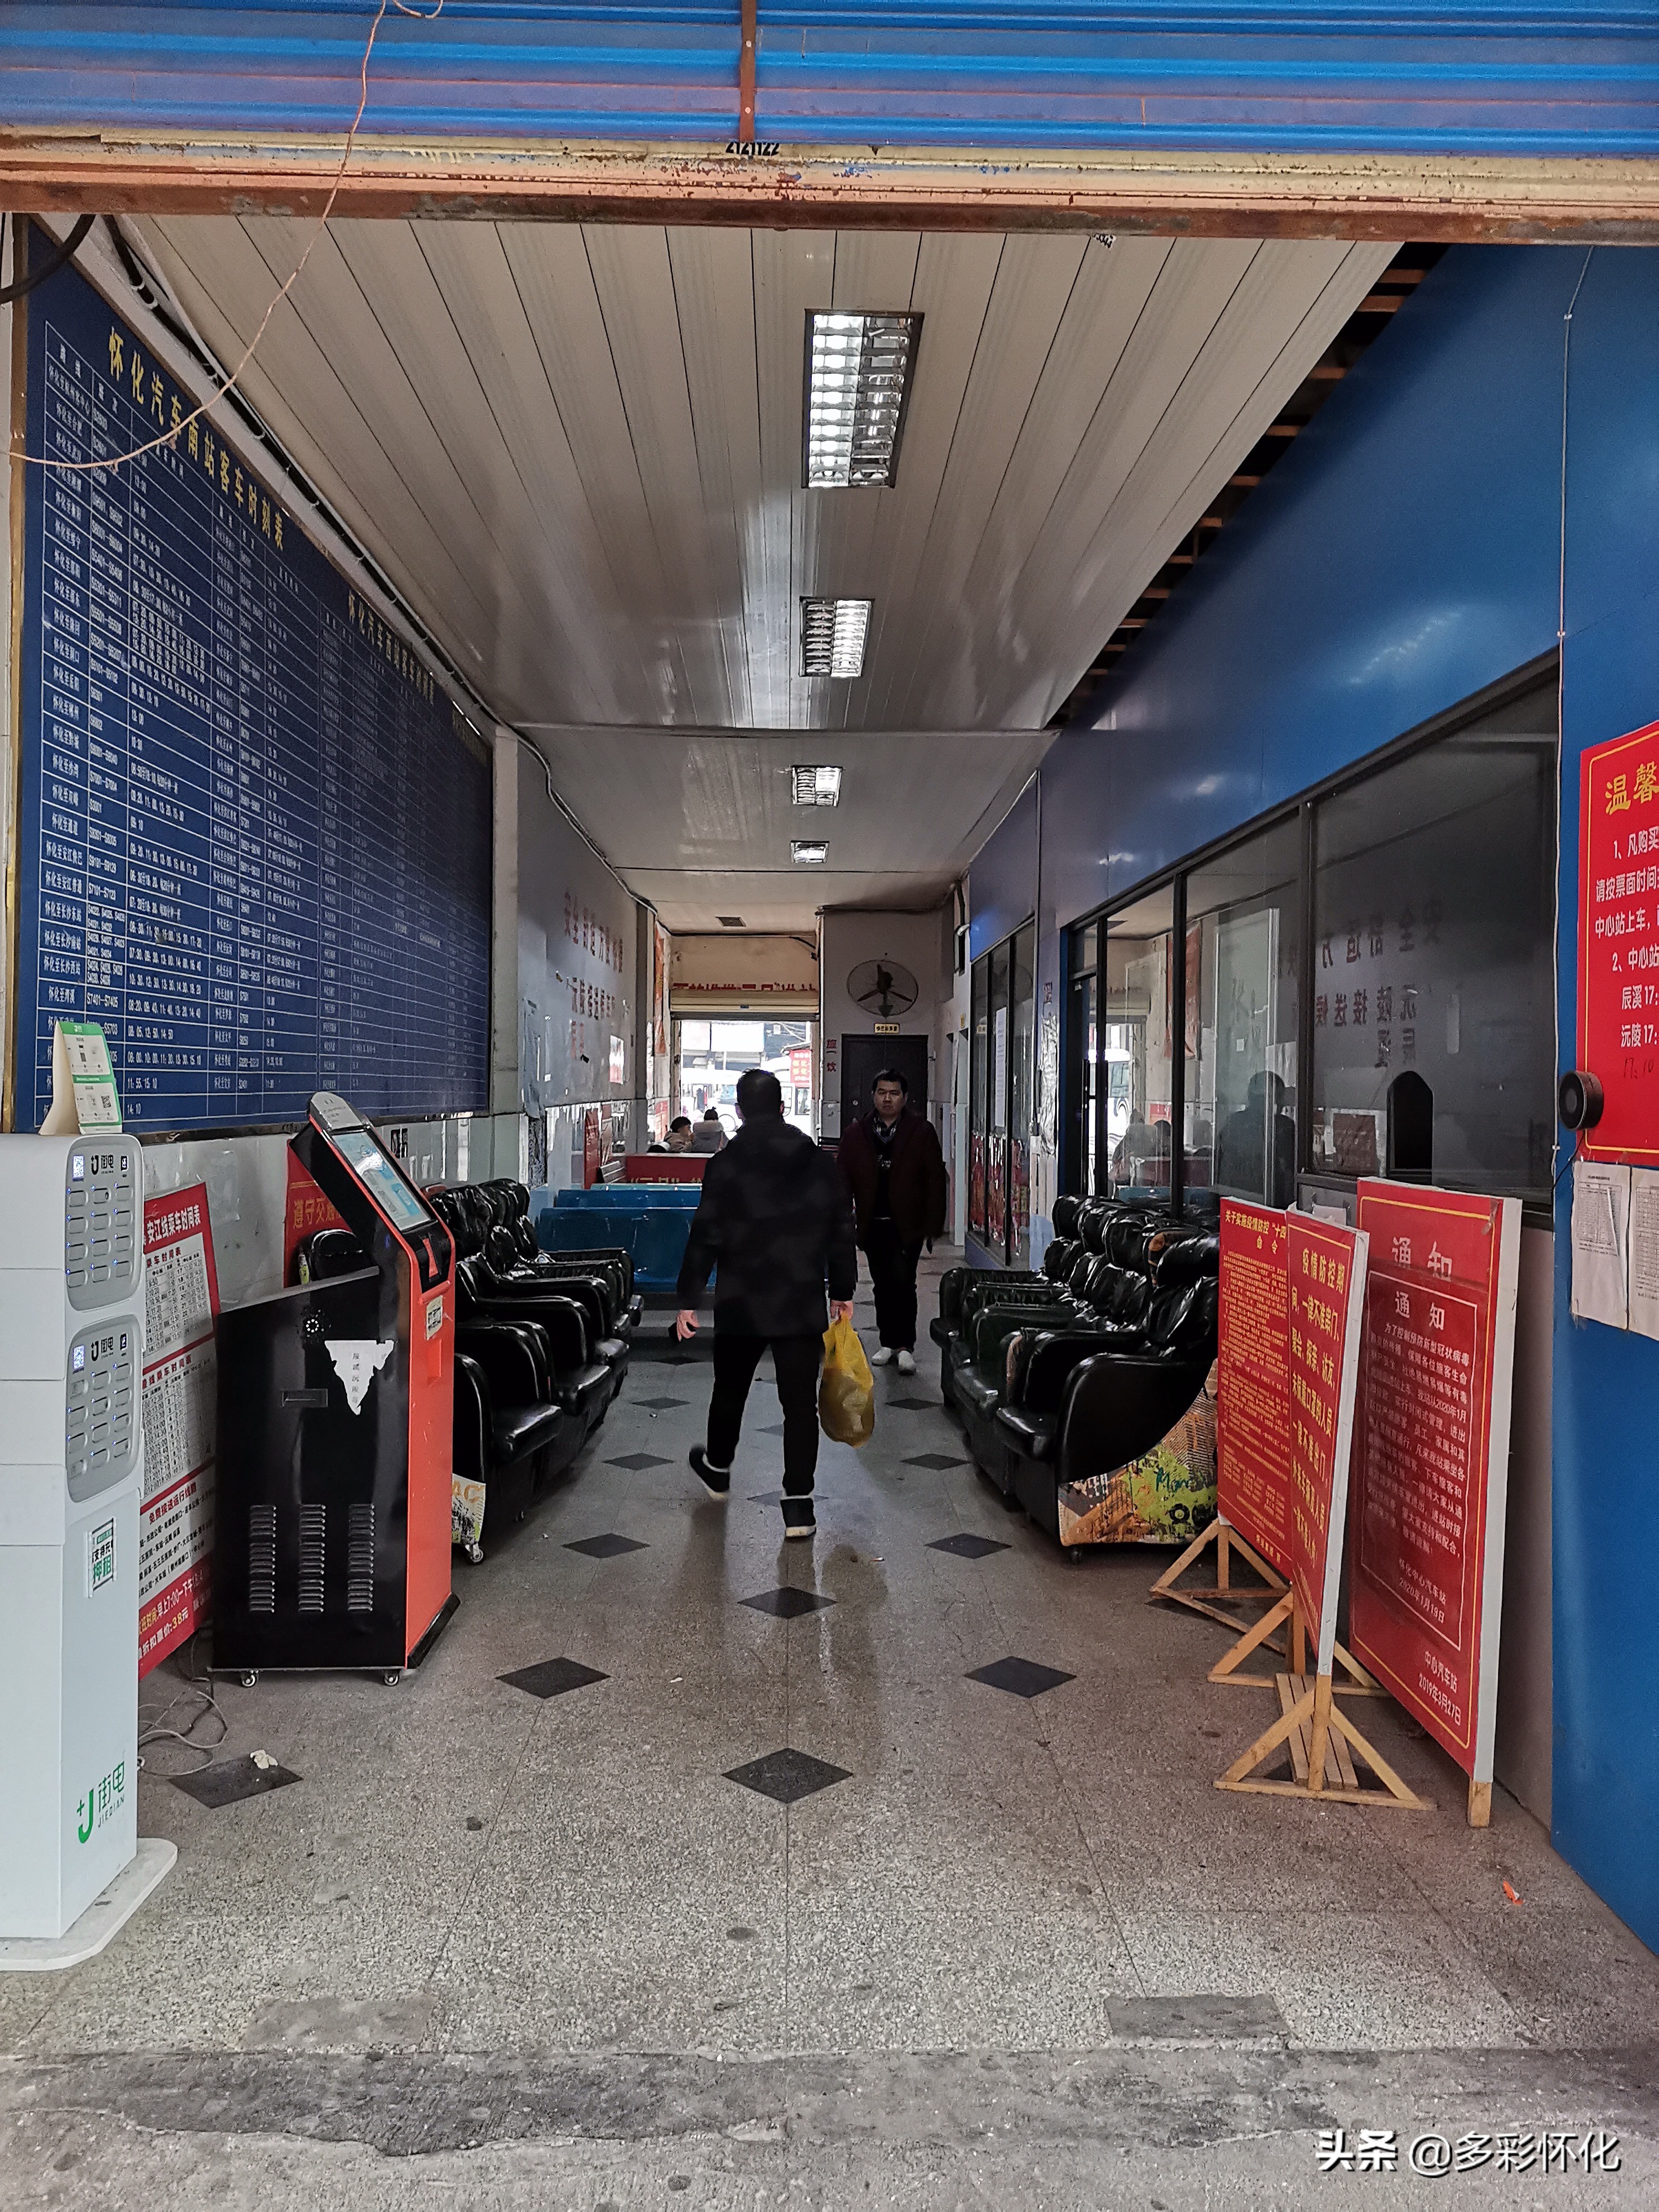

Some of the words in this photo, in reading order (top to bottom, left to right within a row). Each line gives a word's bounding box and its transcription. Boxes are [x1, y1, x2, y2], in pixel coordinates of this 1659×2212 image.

[109, 326, 283, 551] 怀化汽车南站客车时刻表
[1605, 761, 1659, 815] 温馨
[1596, 865, 1659, 902] 请按票面时间
[1595, 904, 1659, 939] 中心站上车，
[1302, 1248, 1345, 1294] 疫情防控期
[1395, 1289, 1446, 1332] 通知
[1385, 1321, 1469, 1368] 为了控制预防新型冠状病毒
[1425, 1650, 1458, 1694] 中心汽车站
[98, 1761, 124, 1813] 街电
[98, 1794, 124, 1828] JIEDIAN
